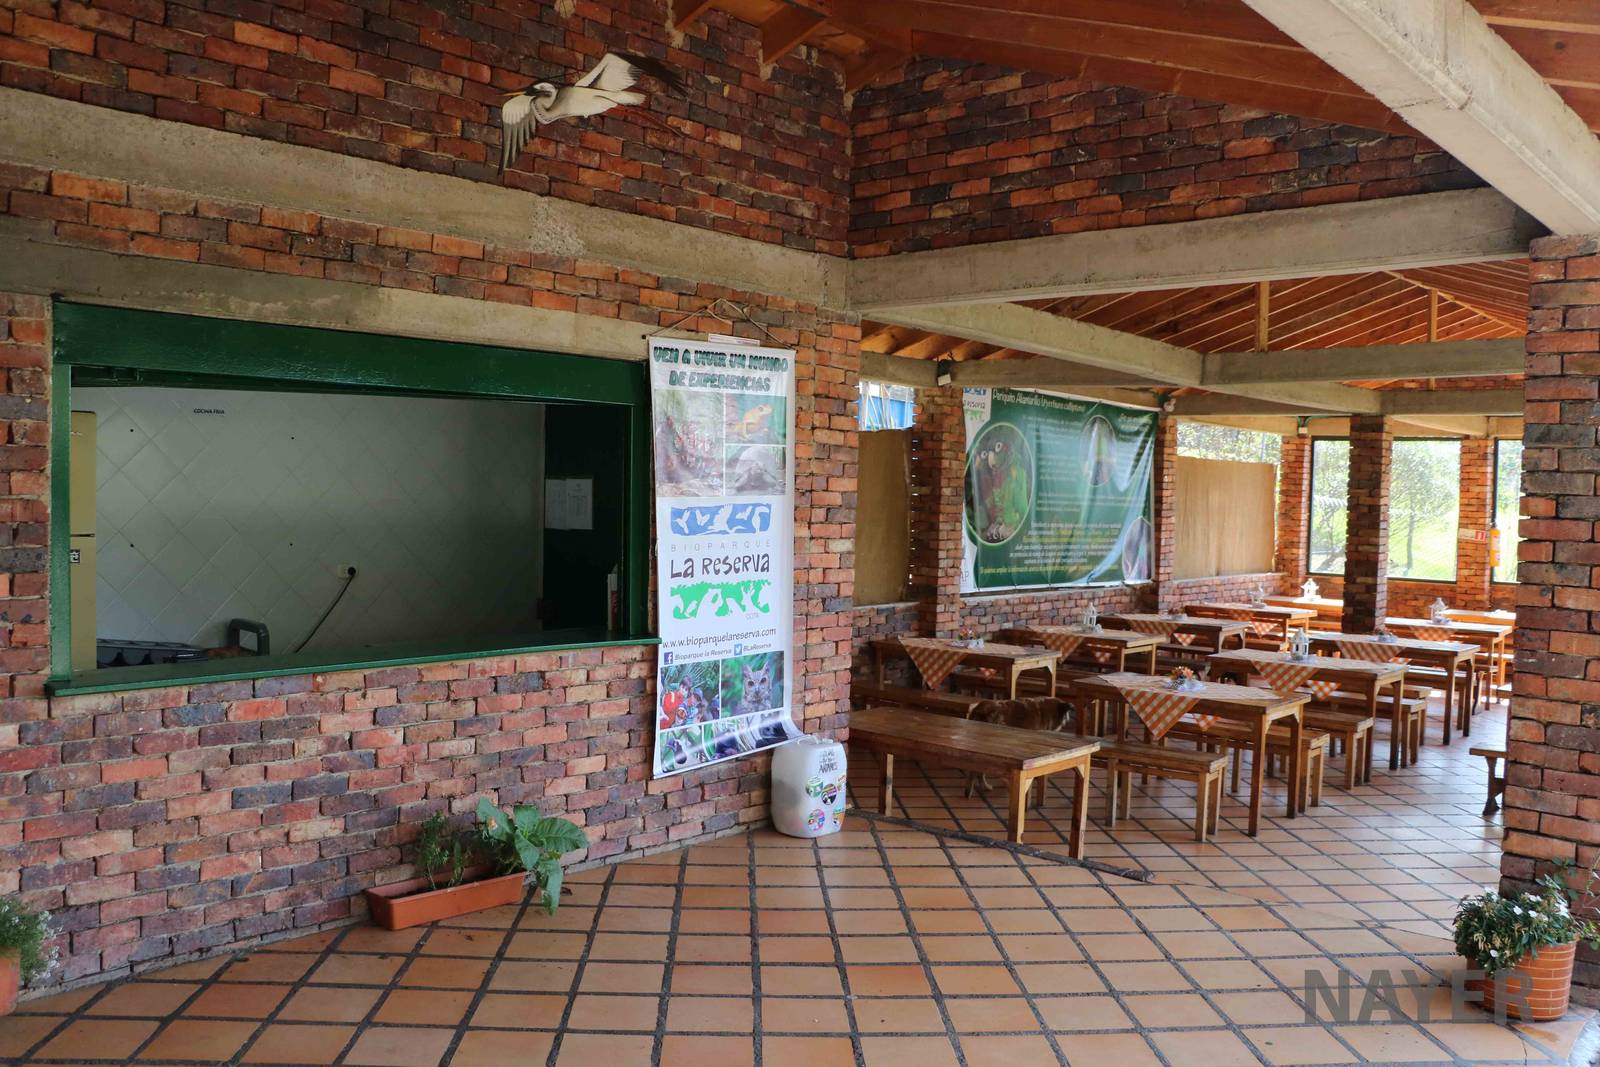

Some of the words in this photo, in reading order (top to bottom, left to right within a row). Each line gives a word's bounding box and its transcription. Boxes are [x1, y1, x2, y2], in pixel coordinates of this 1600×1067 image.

[653, 346, 680, 364] VEN
[682, 348, 691, 365] A
[694, 349, 727, 368] VIVIR
[729, 353, 747, 369] UN
[748, 354, 789, 373] MUNDO
[669, 370, 687, 386] DE
[689, 372, 770, 391] EXPERIENCIAS
[670, 540, 772, 553] BIOPARQUE
[670, 557, 695, 579] La
[674, 651, 704, 661] Bioparque
[711, 647, 732, 657] Reserva
